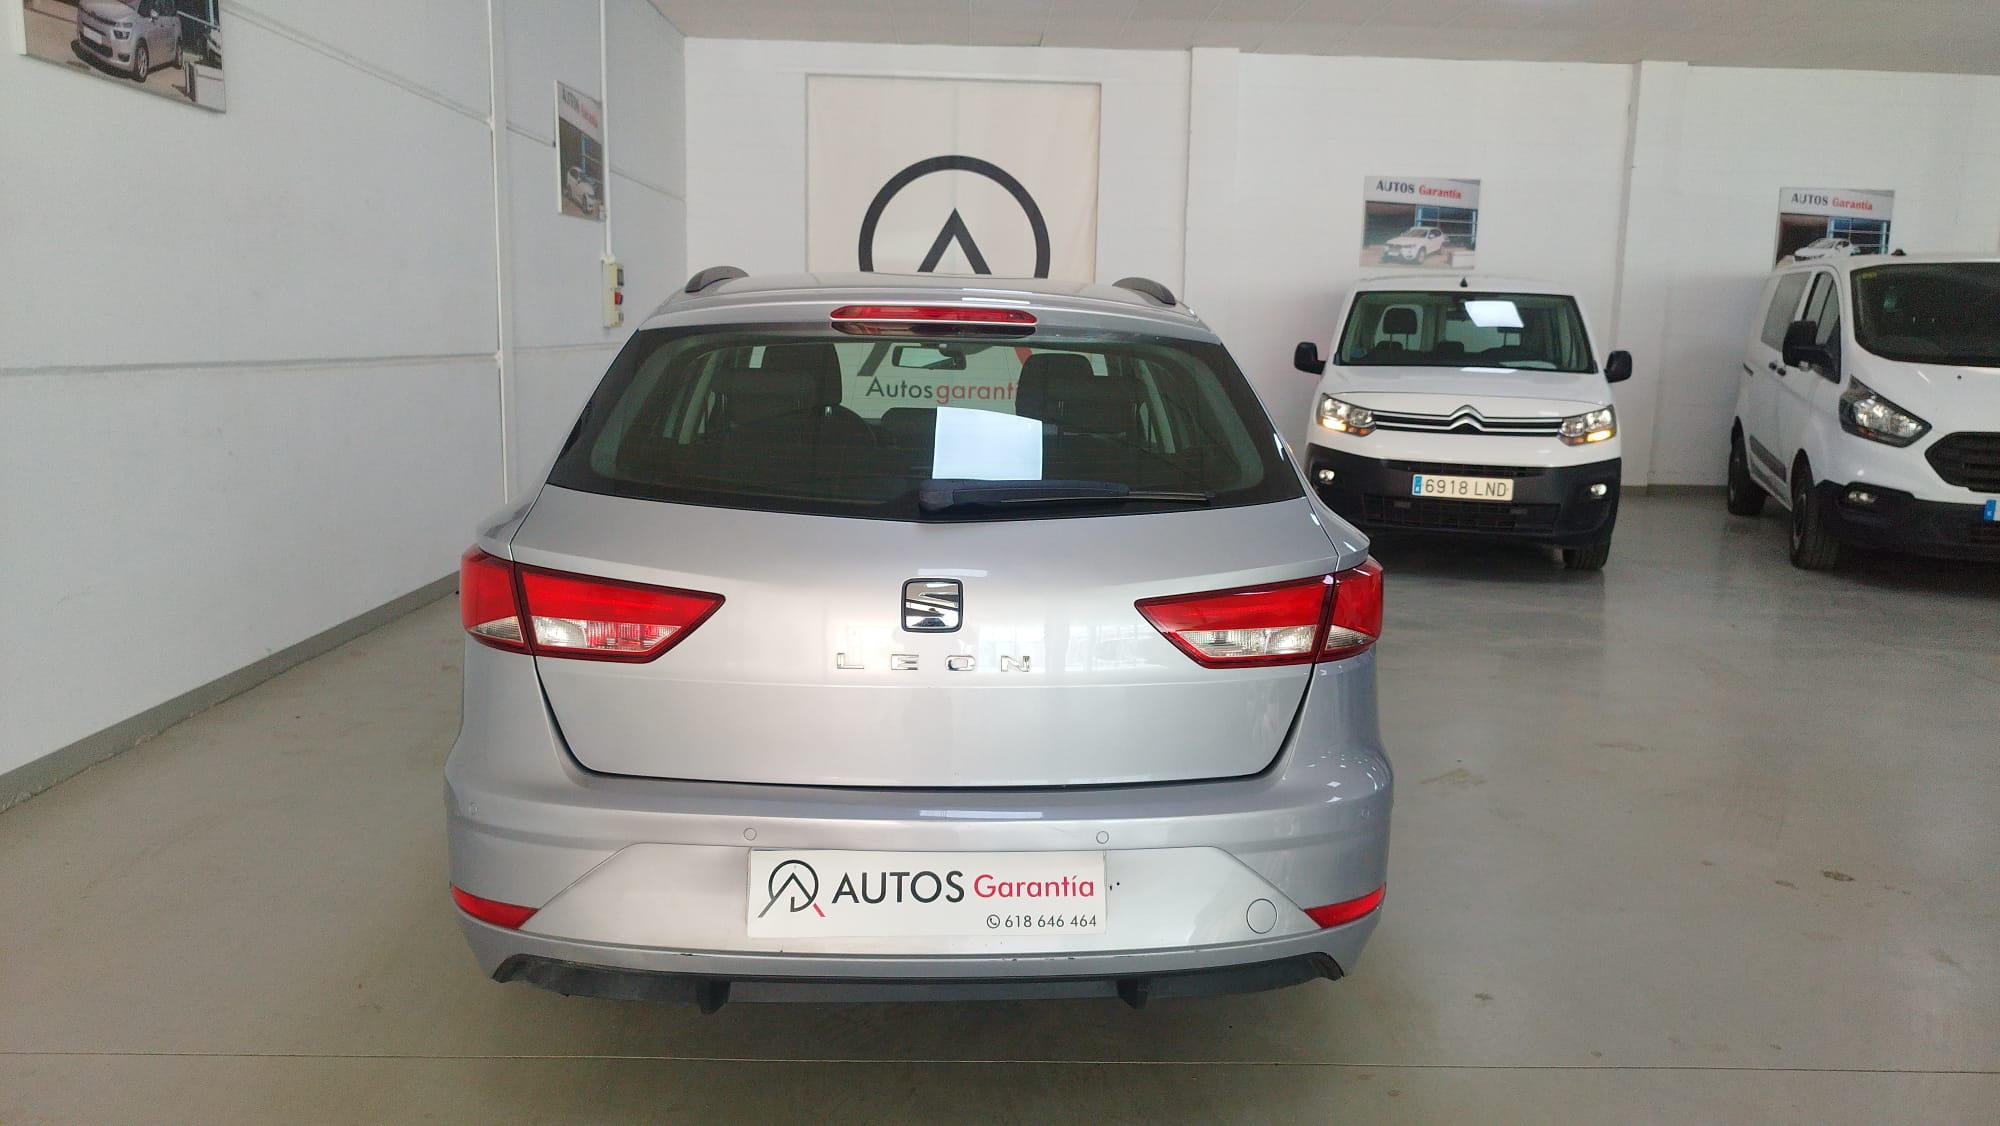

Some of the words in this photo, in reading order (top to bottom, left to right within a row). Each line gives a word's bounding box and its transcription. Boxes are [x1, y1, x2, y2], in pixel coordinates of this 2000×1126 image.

[1376, 180, 1415, 194] AUTOS
[1792, 193, 1829, 206] AUTOS
[1425, 479, 1468, 495] 6918
[1474, 480, 1507, 497] LND
[837, 653, 1030, 672] LEON
[831, 870, 965, 904] AUTOS
[973, 874, 1095, 899] Garantía
[1004, 915, 1033, 928] 618
[1037, 915, 1065, 928] 646
[1070, 915, 1097, 928] 464
